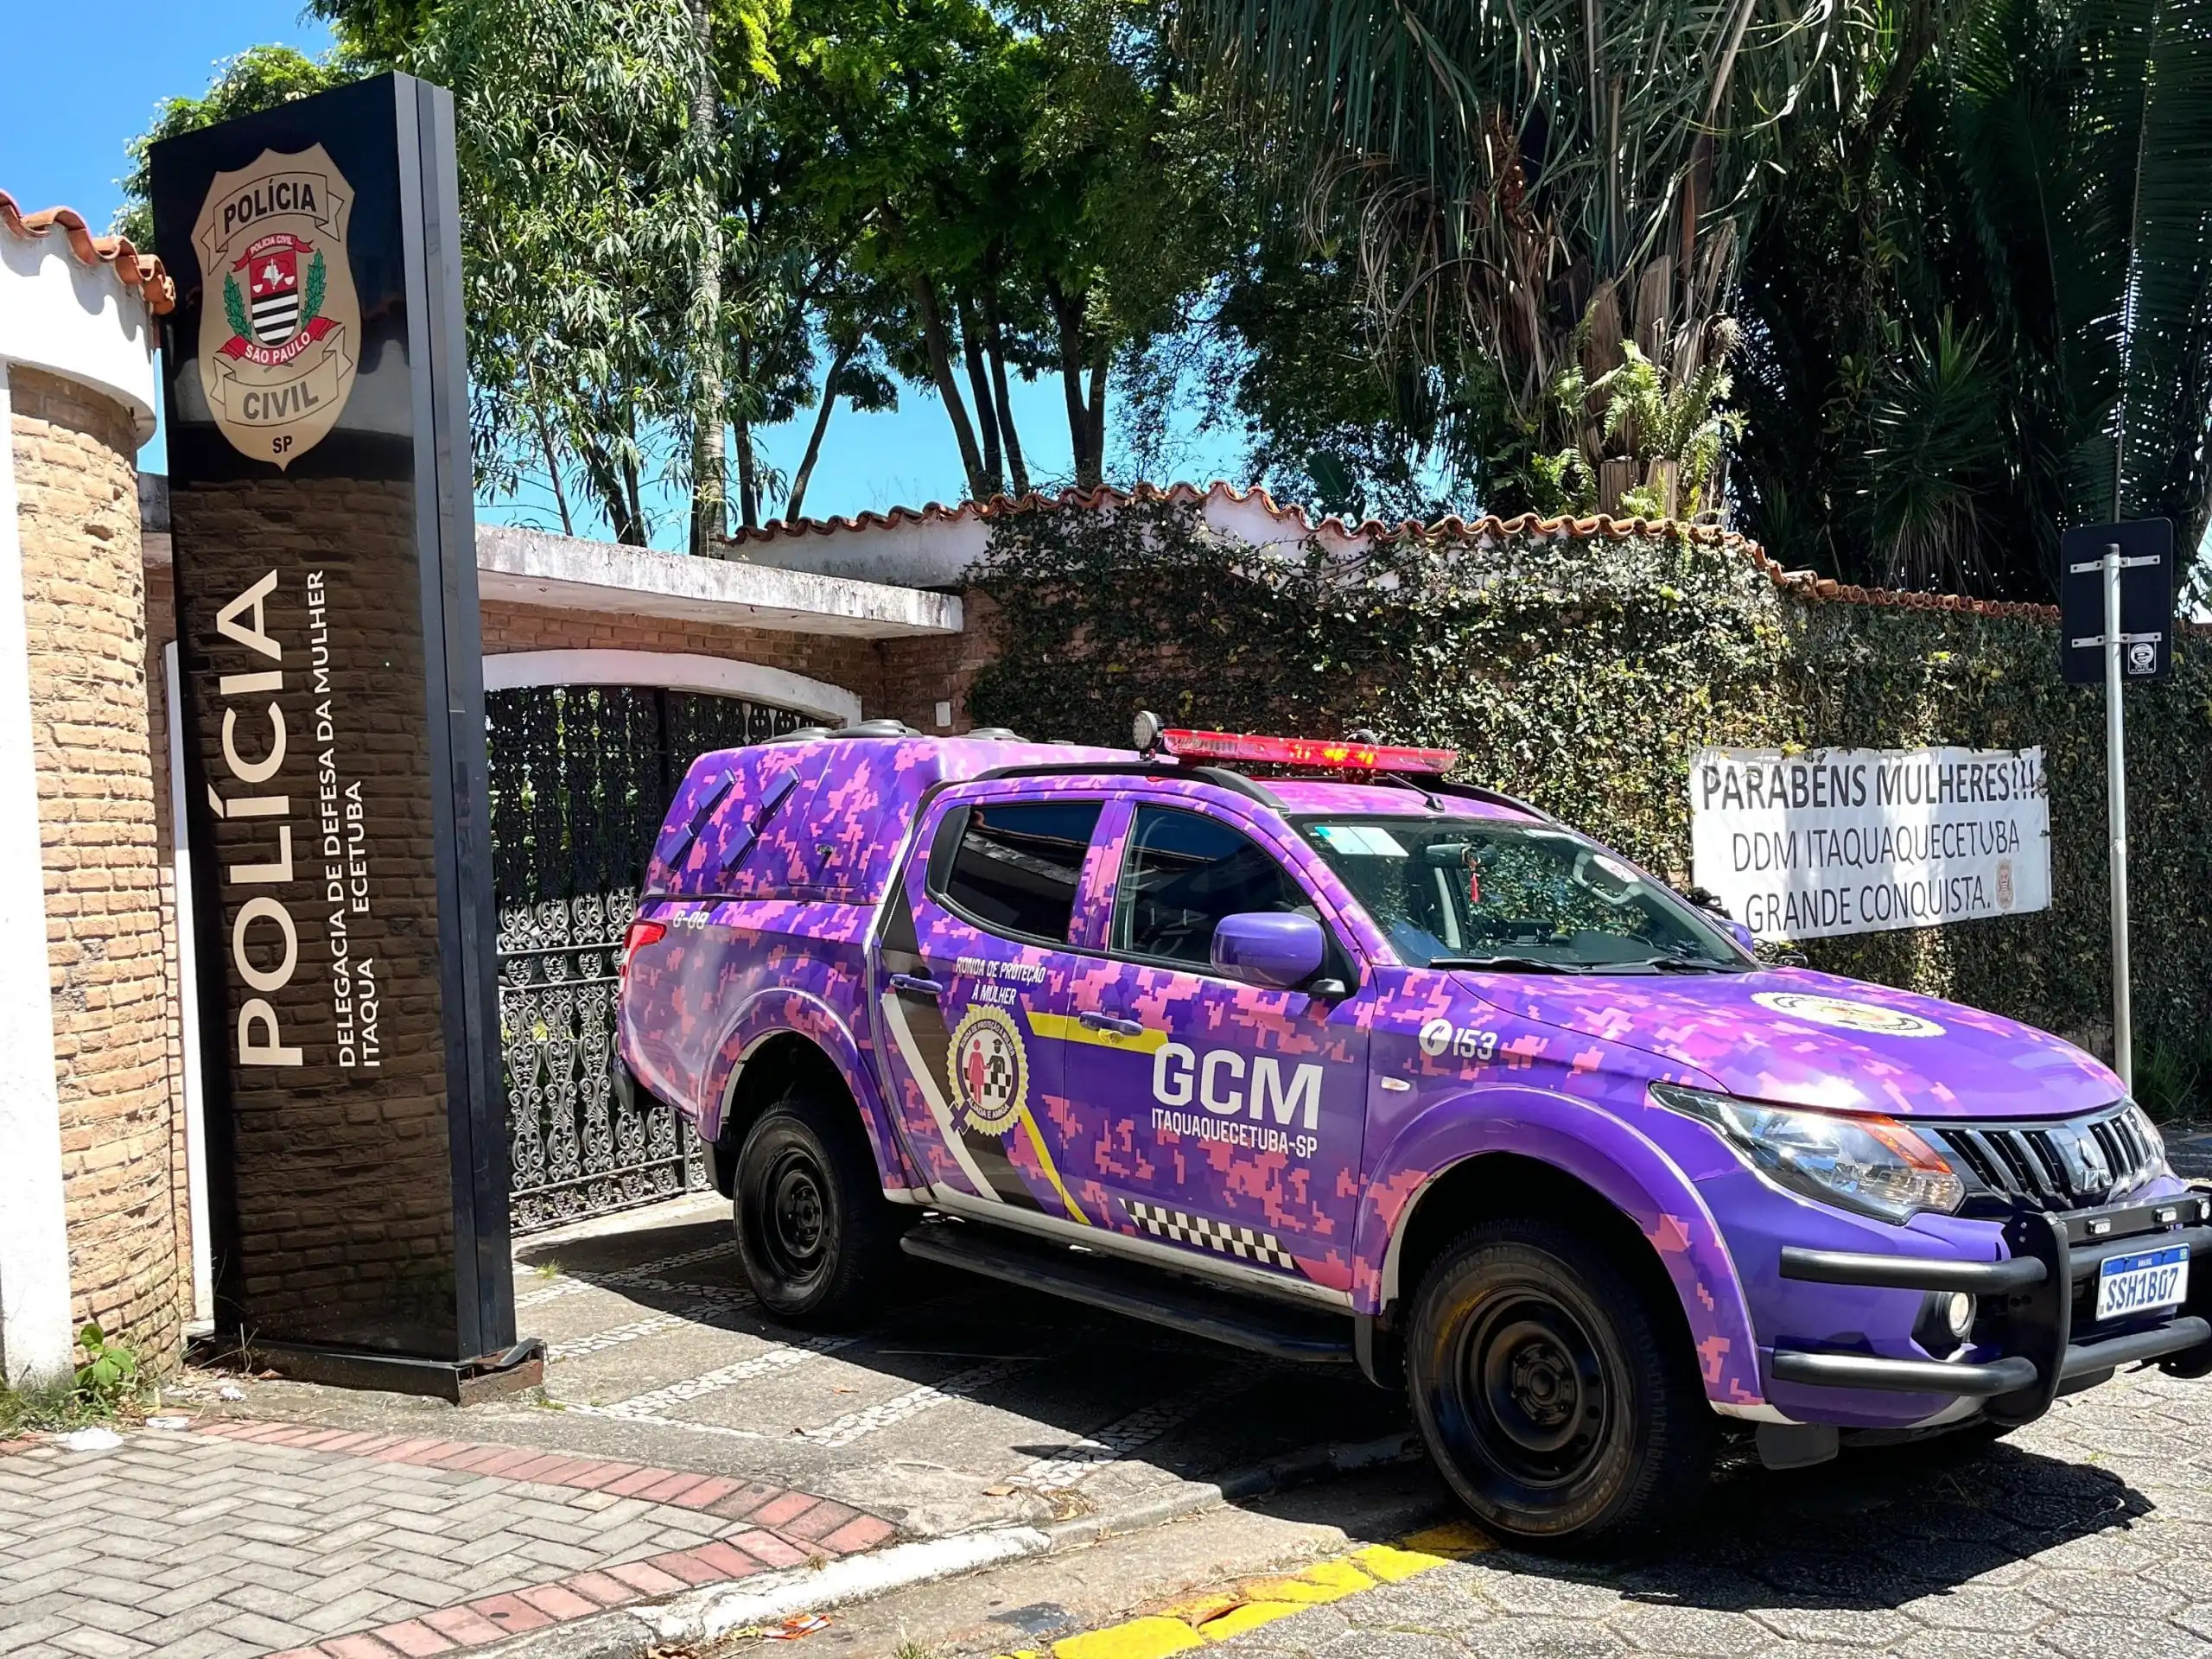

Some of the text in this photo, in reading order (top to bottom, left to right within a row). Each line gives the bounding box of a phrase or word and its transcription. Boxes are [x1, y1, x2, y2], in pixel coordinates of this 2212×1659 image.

[224, 178, 316, 235] POLÍCIA
[276, 235, 293, 245] CIVIL
[272, 332, 310, 364] PAULO
[243, 381, 319, 420] CIVIL
[272, 435, 292, 454] SP
[1877, 760, 2036, 805] MULHERES!!!
[208, 569, 302, 1066] POLÍCIA
[307, 570, 356, 1067] DELEGACIA DE DEFESA DA MULHER
[1732, 819, 2019, 872] DDM ITAQUAQUECETUBA
[345, 780, 381, 1067] ITAQUA ECETUBA
[1745, 875, 1991, 933] GRANDE CONQUISTA.
[956, 957, 1046, 986] RONDA DE PROTEÇÃO
[971, 979, 1017, 1005] À MULHER
[1453, 1027, 1498, 1059] 153
[1153, 1042, 1324, 1130] GCM
[1152, 1107, 1318, 1159] ITAQUAQUECETUBA-SP
